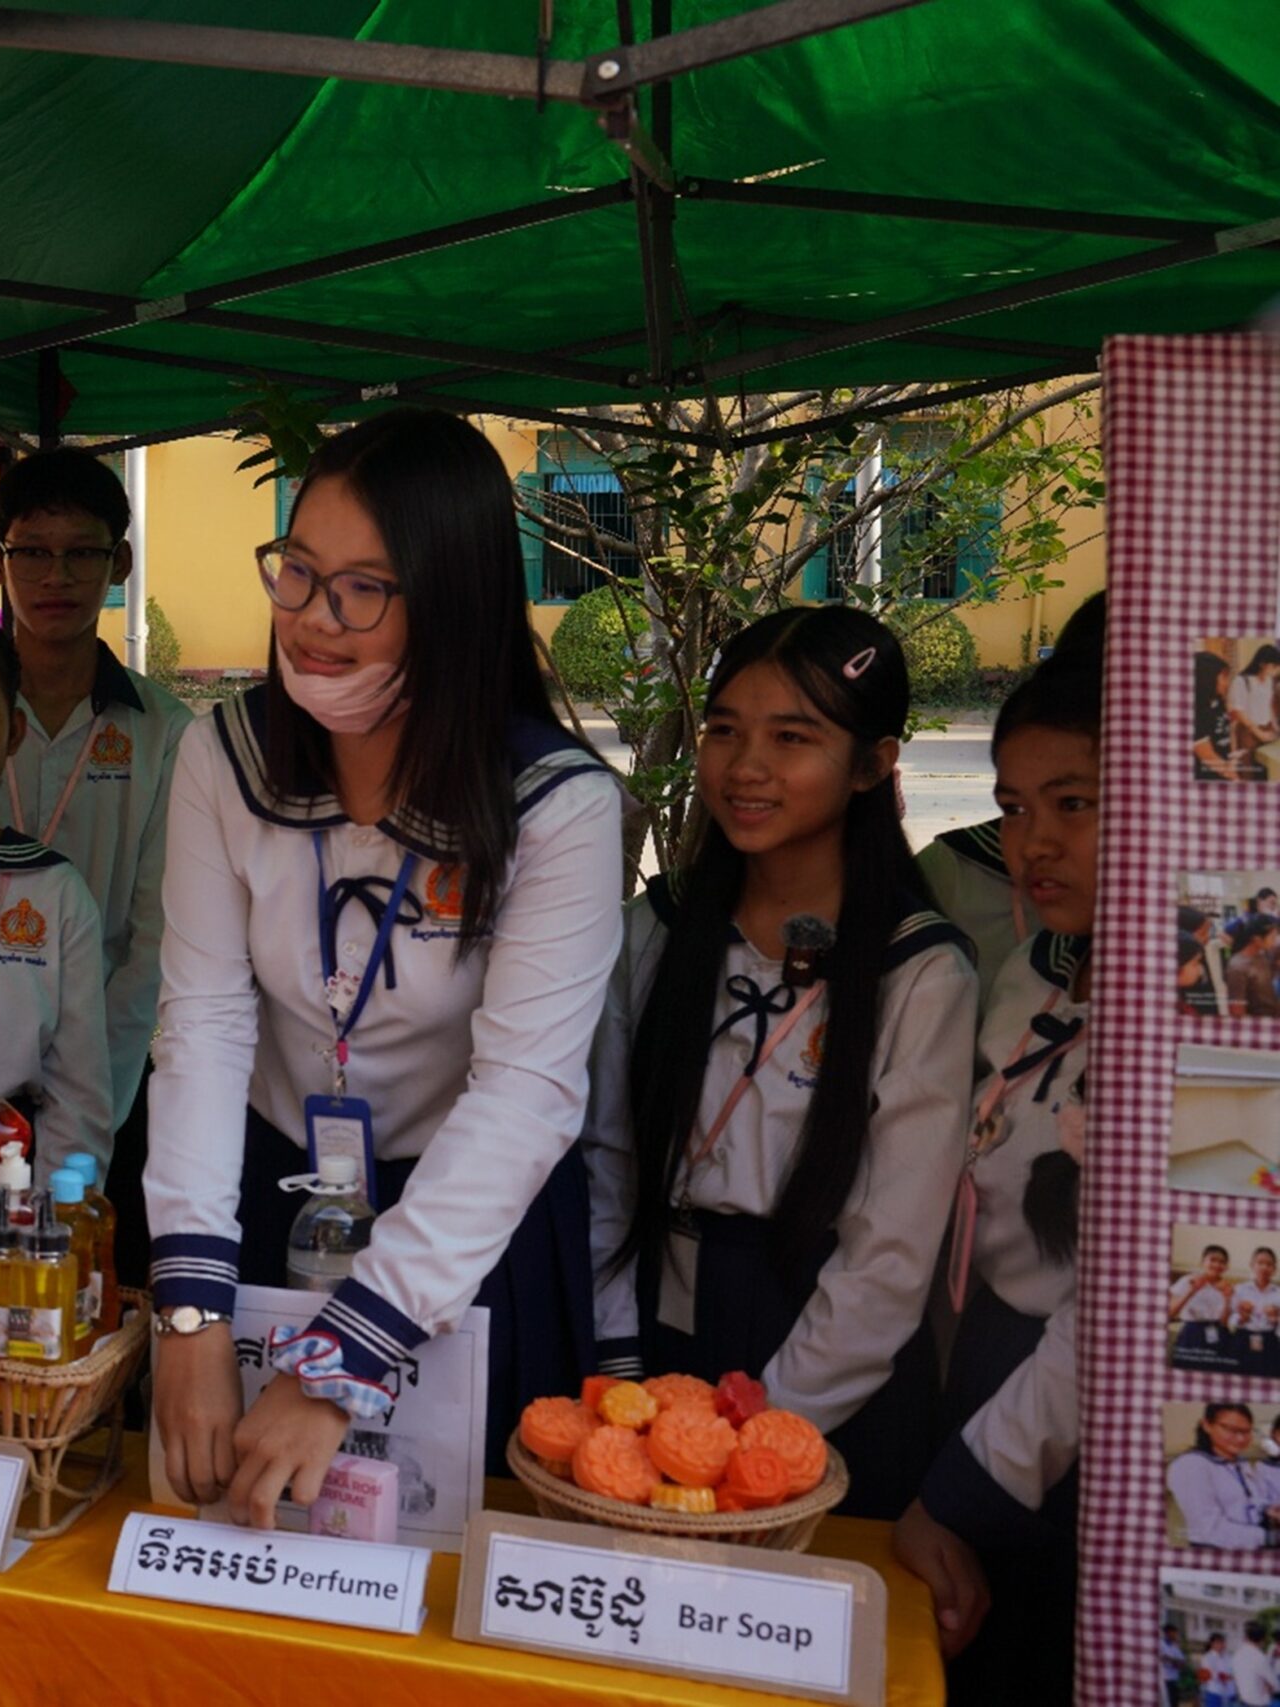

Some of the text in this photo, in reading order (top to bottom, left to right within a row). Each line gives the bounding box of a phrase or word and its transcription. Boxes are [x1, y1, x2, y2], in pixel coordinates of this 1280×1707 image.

[137, 1527, 399, 1600] ទឹកអប់ Perfume
[678, 1603, 728, 1634] Bar
[736, 1612, 813, 1651] Soap
